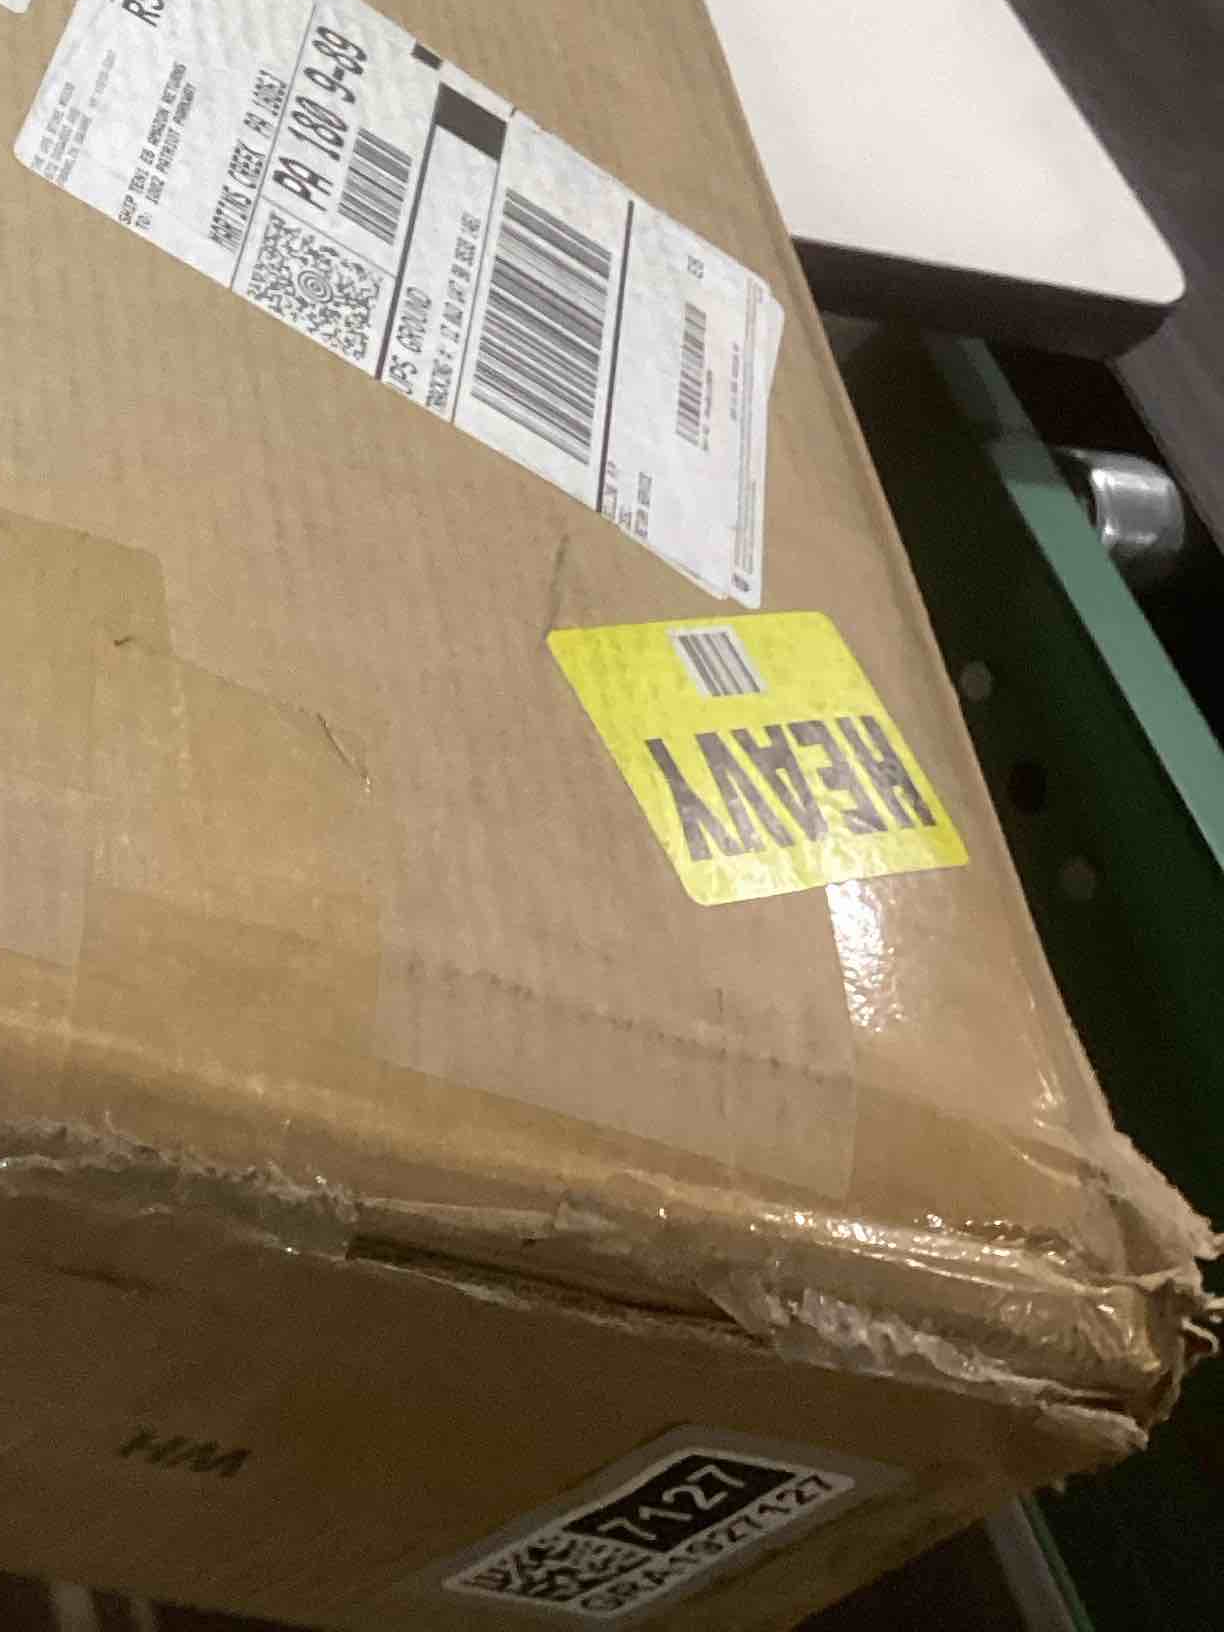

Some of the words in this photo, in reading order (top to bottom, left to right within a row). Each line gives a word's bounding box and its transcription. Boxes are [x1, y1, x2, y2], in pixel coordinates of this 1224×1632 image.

[302, 24, 368, 105] 9-89
[287, 95, 349, 162] 180
[228, 138, 266, 190] CREEK
[272, 156, 334, 212] PA
[396, 285, 433, 354] GROUND
[643, 713, 938, 863] HEAVY
[595, 1462, 748, 1545] 7127
